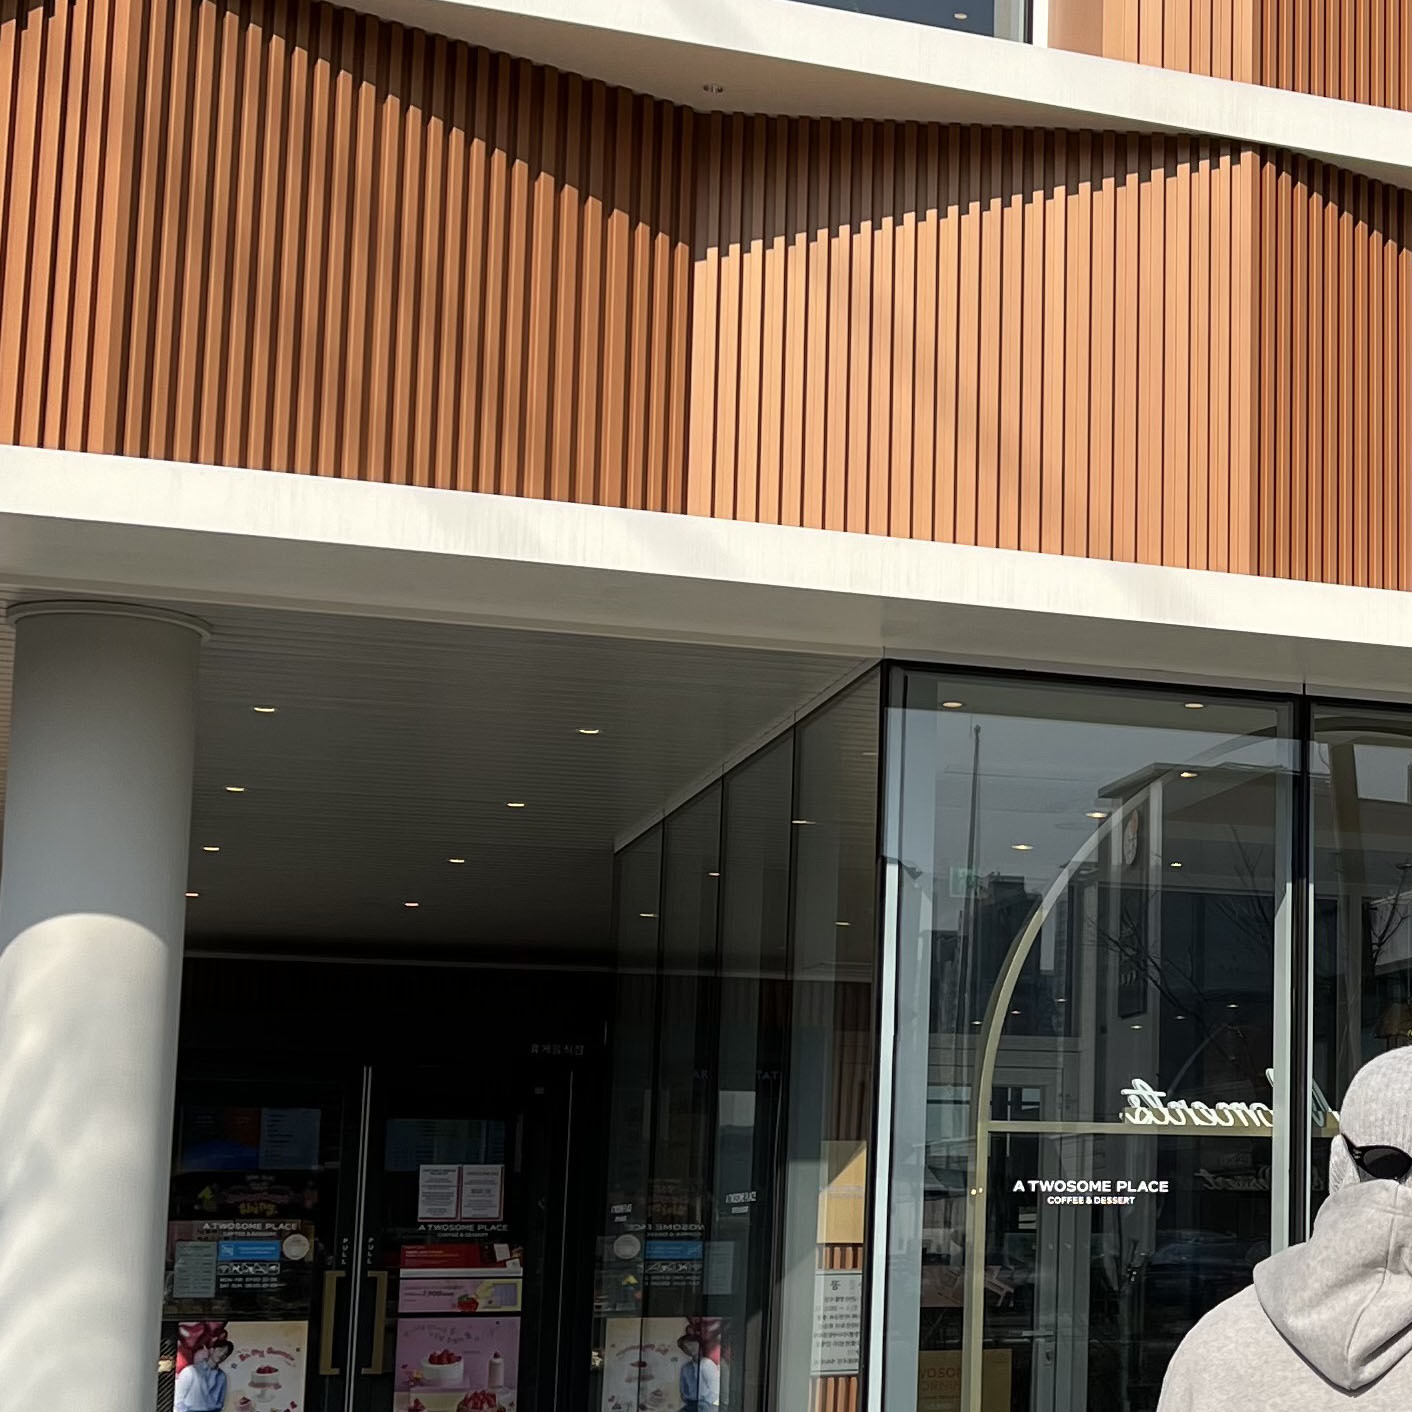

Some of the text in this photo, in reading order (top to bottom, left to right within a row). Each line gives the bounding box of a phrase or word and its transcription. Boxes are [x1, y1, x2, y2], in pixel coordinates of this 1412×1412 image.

[1013, 1180, 1169, 1193] A TWOSOME PLACE
[1047, 1196, 1084, 1205] COFFEE
[1093, 1196, 1135, 1205] DESSERT
[210, 1222, 262, 1231] TWOSOME
[265, 1222, 297, 1231] PLACE
[418, 1224, 509, 1232] A TWOSOME PLACE
